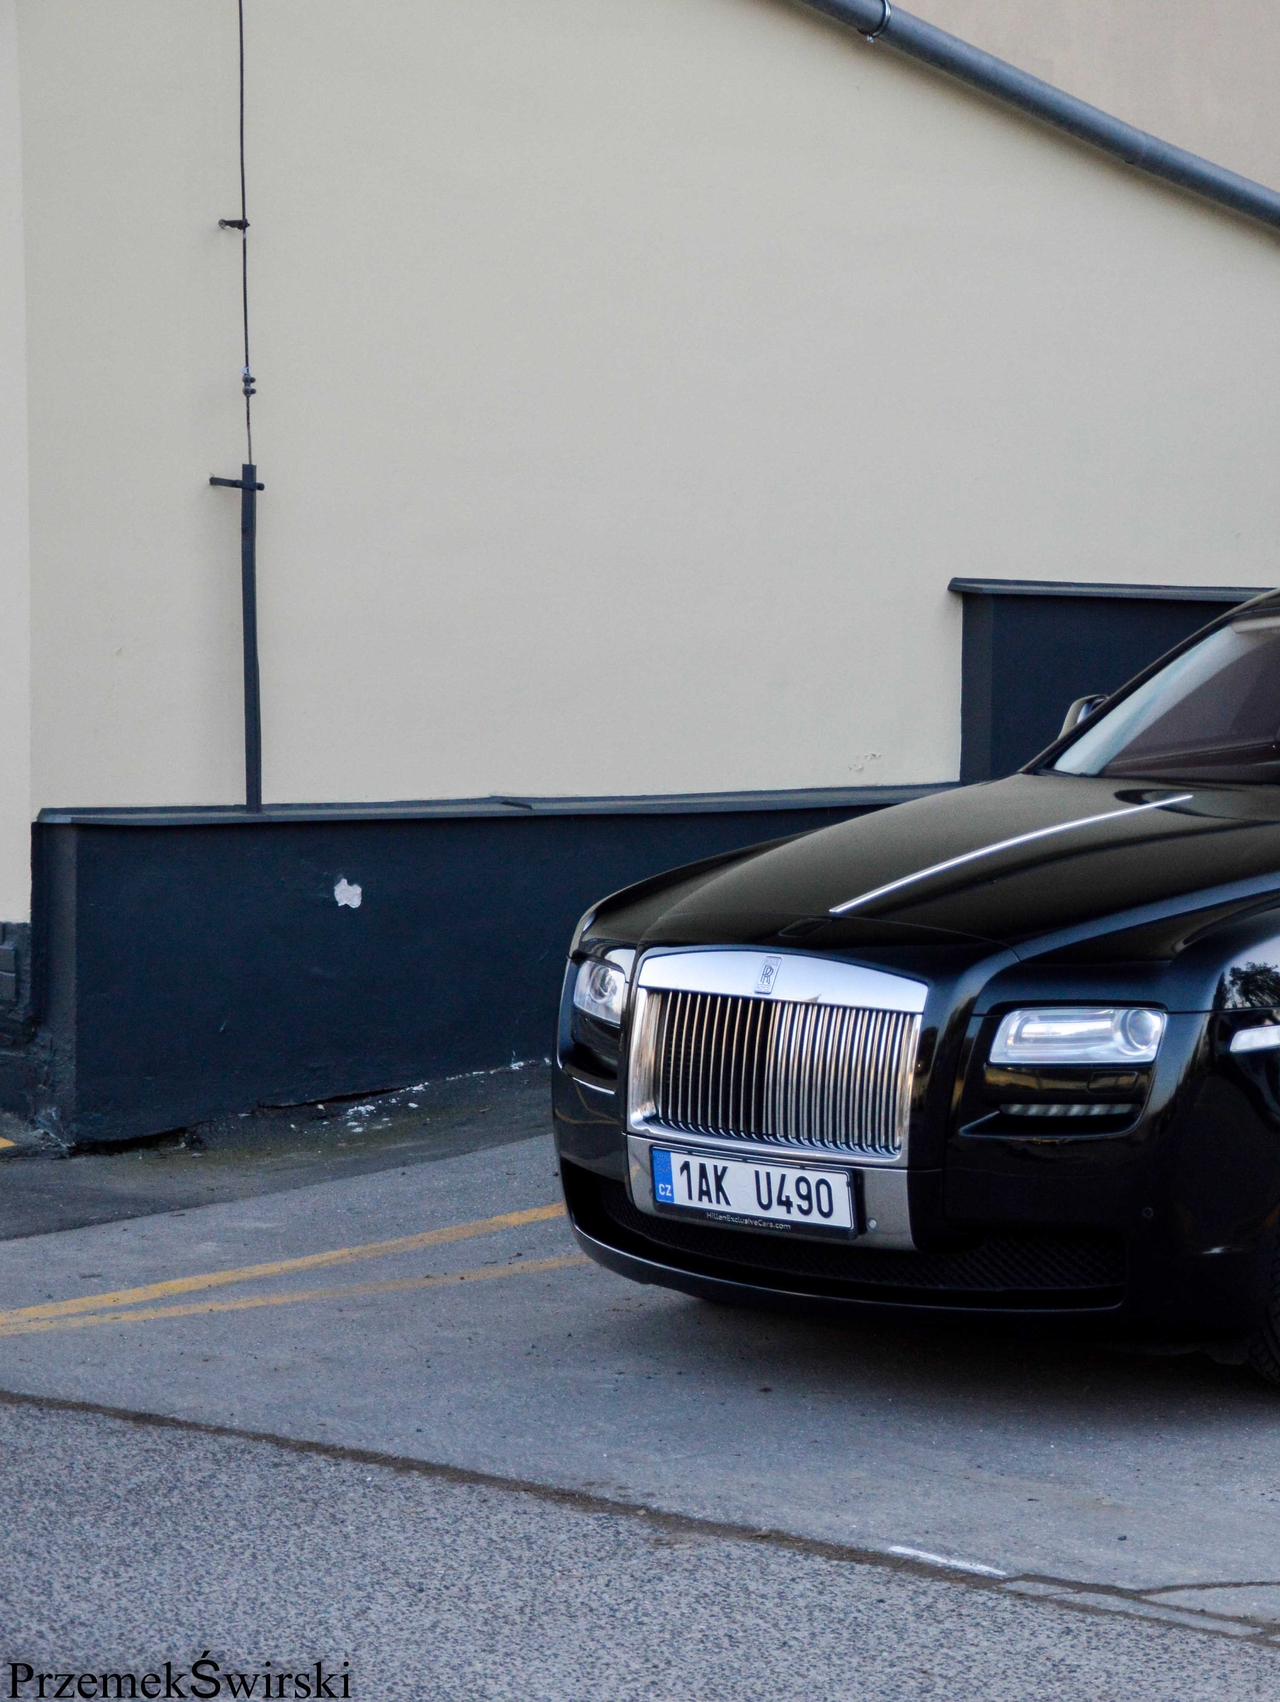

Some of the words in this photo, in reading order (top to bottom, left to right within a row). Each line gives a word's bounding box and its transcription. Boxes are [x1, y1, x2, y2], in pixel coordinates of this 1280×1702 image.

[658, 1183, 672, 1197] CZ
[679, 1160, 732, 1206] 1AK
[754, 1169, 834, 1219] U490
